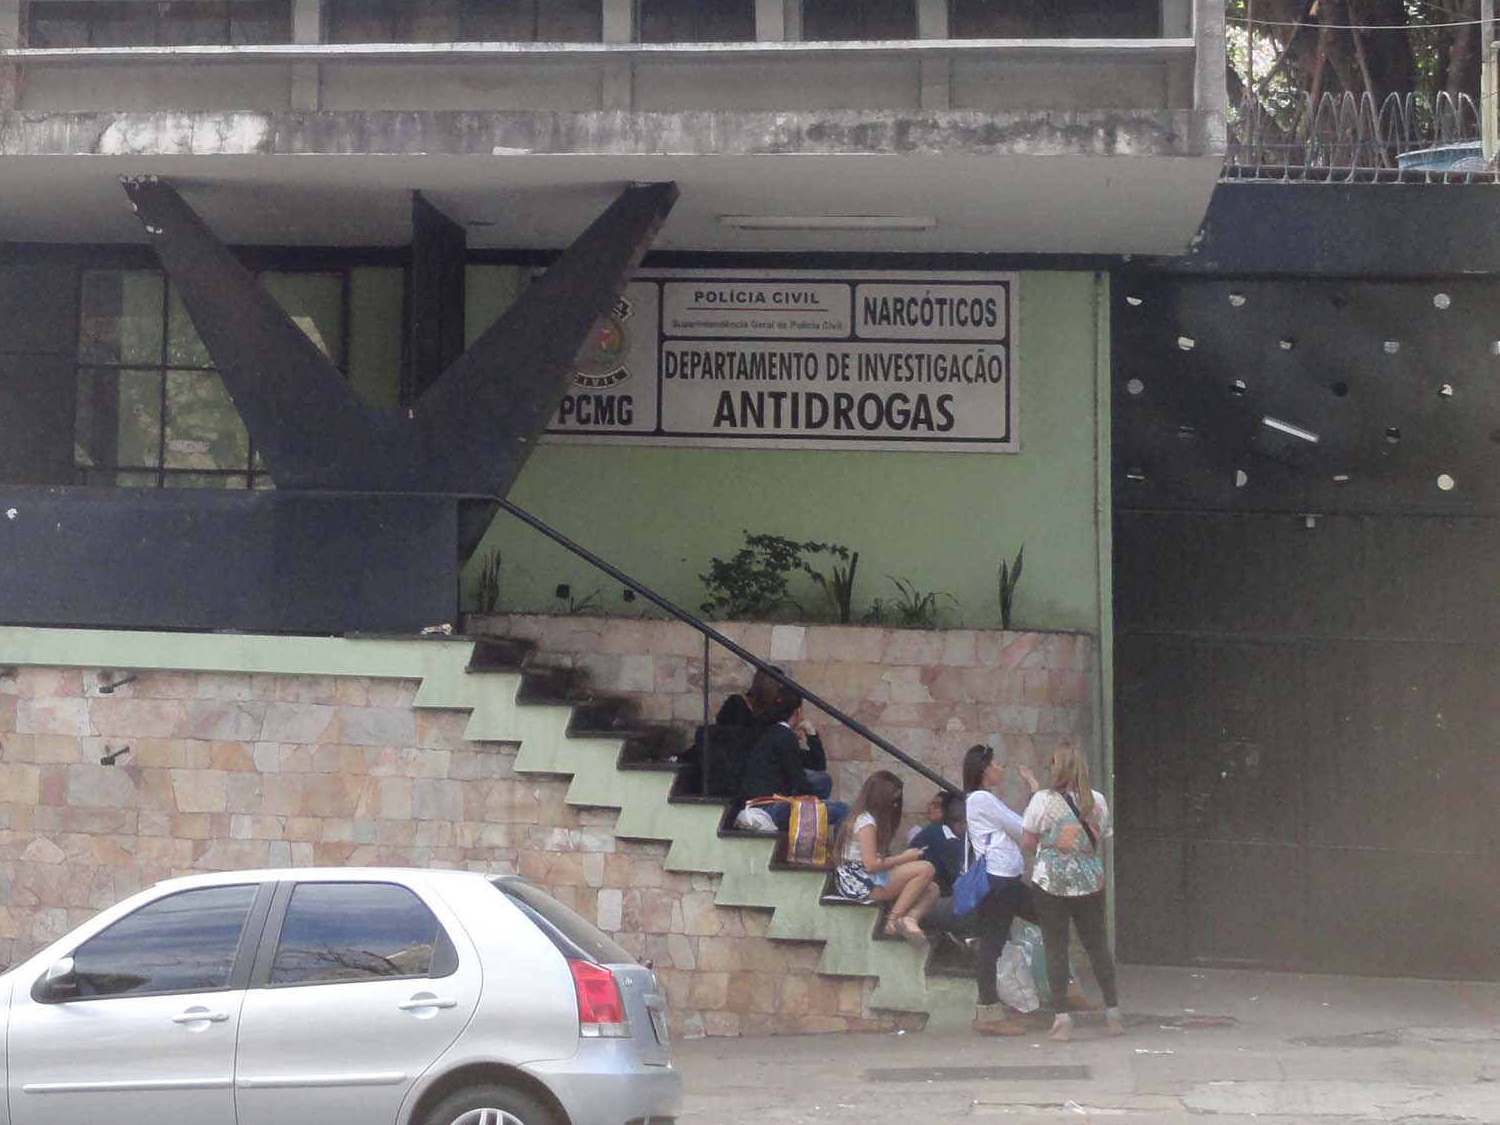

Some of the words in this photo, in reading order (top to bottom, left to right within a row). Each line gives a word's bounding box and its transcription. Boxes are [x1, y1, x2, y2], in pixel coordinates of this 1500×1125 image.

[694, 290, 766, 304] POLÍCIA
[772, 291, 820, 304] CIVIL
[863, 290, 997, 327] NARCÓTICOS
[663, 350, 819, 382] DEPARTAMENTO
[826, 352, 850, 382] DE
[857, 348, 1002, 385] INVESTIGAÇÃO
[558, 394, 633, 426] PCMG
[713, 390, 956, 433] ANTIDROGAS
